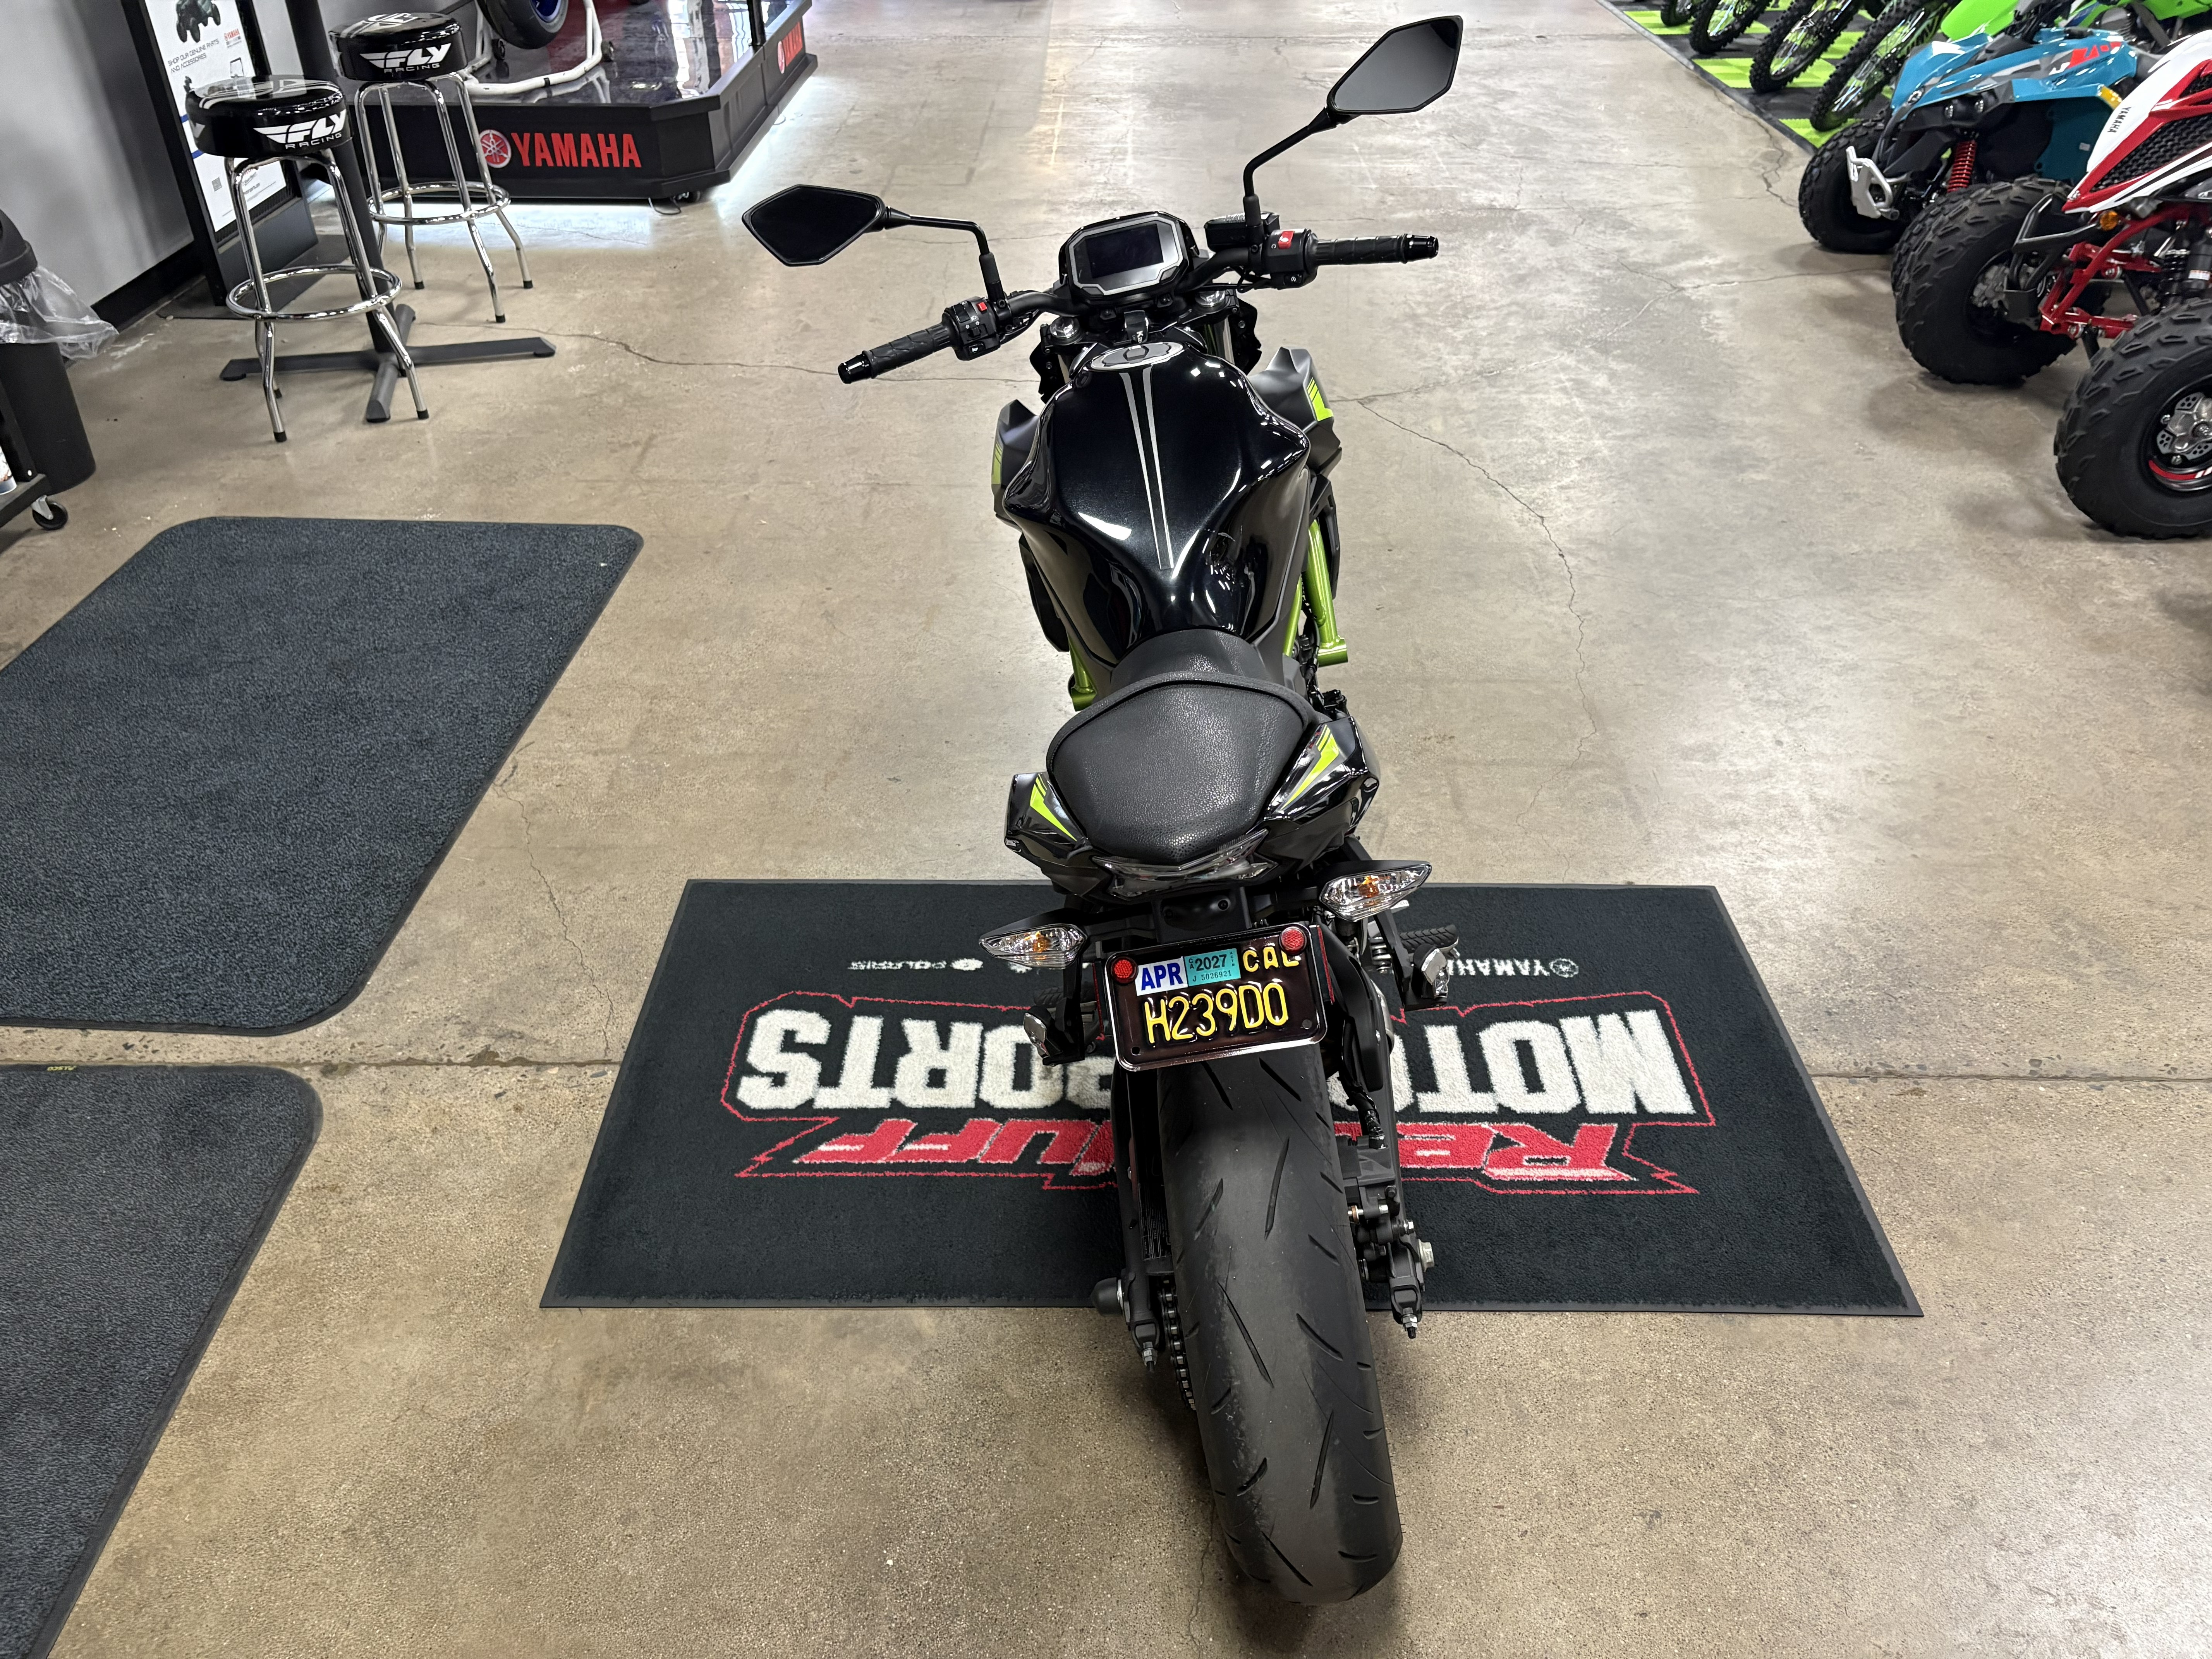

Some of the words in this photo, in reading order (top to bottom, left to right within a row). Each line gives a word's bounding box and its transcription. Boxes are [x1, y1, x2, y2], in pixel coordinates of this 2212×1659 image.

[180, 52, 189, 60] OUR
[385, 43, 451, 68] FLY
[384, 63, 440, 74] RACING
[285, 109, 346, 143] FLY
[2107, 107, 2132, 132] YAMAHA
[285, 132, 342, 149] RACING
[511, 133, 641, 168] YAMAHA
[1195, 954, 1227, 972] 2027
[1243, 946, 1299, 972] CAL
[1141, 963, 1183, 991] APR
[1201, 970, 1231, 981] 5026921
